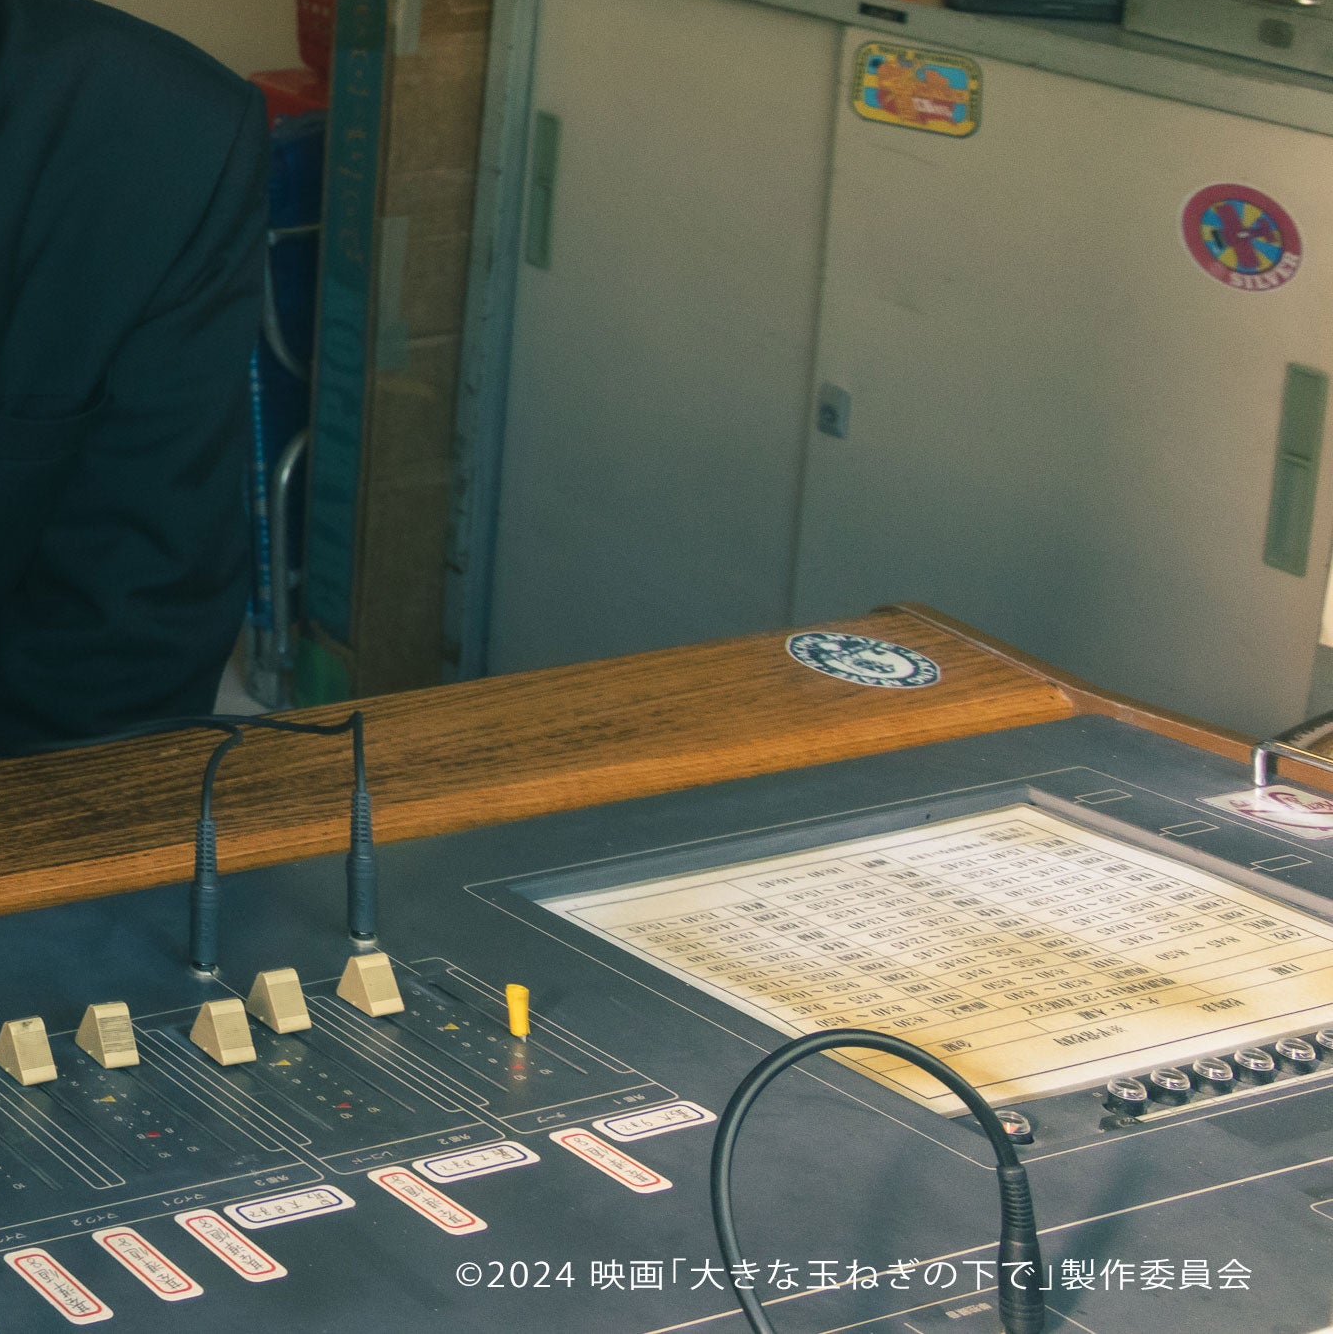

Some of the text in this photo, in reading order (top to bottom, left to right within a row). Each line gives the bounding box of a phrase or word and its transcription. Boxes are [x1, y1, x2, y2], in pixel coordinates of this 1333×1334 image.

[1228, 250, 1301, 291] SILVER
[1084, 957, 1127, 968] SHR
[1262, 963, 1308, 975] 月曜
[923, 992, 966, 1004] SHR
[1192, 997, 1248, 1012] 校時表
[934, 1039, 977, 1052] 金曜
